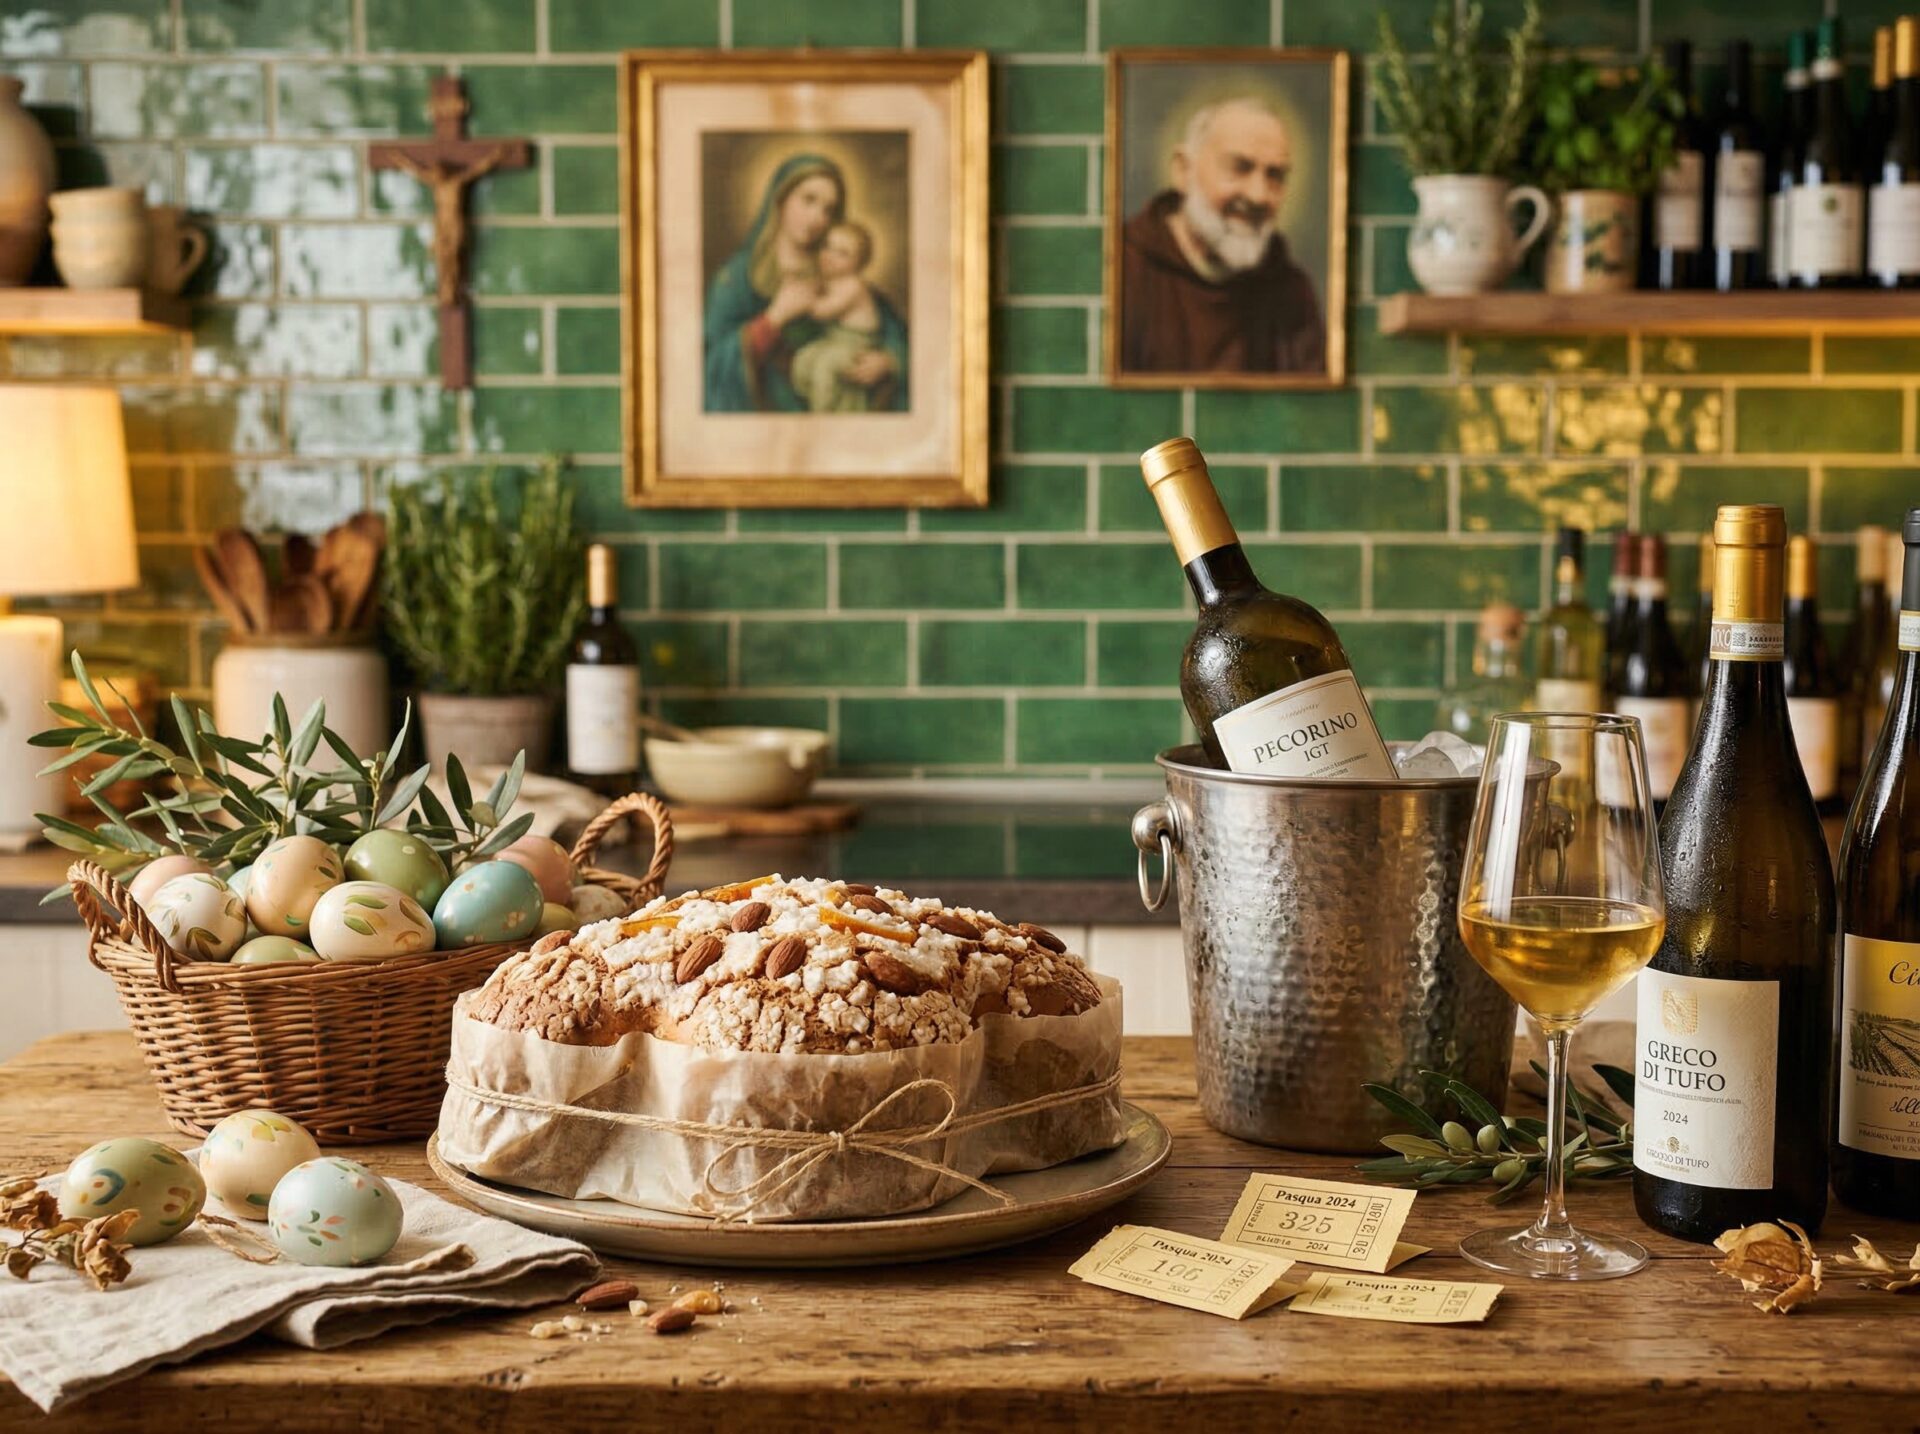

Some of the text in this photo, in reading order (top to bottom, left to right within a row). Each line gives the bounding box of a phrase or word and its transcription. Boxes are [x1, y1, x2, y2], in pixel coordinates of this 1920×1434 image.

[1253, 711, 1358, 764] PECORINO
[1303, 742, 1330, 762] IGT
[1647, 1040, 1717, 1068] GRECO
[1643, 1060, 1726, 1092] DI TUFO
[1663, 1110, 1689, 1125] 2024
[1685, 1158, 1710, 1169] TUFO
[1274, 1189, 1357, 1209] Pasqua 2024
[1279, 1211, 1335, 1234] 325
[1152, 1240, 1198, 1257] Pasqua
[1200, 1252, 1233, 1266] 2024
[1344, 1280, 1398, 1291] Pasqua
